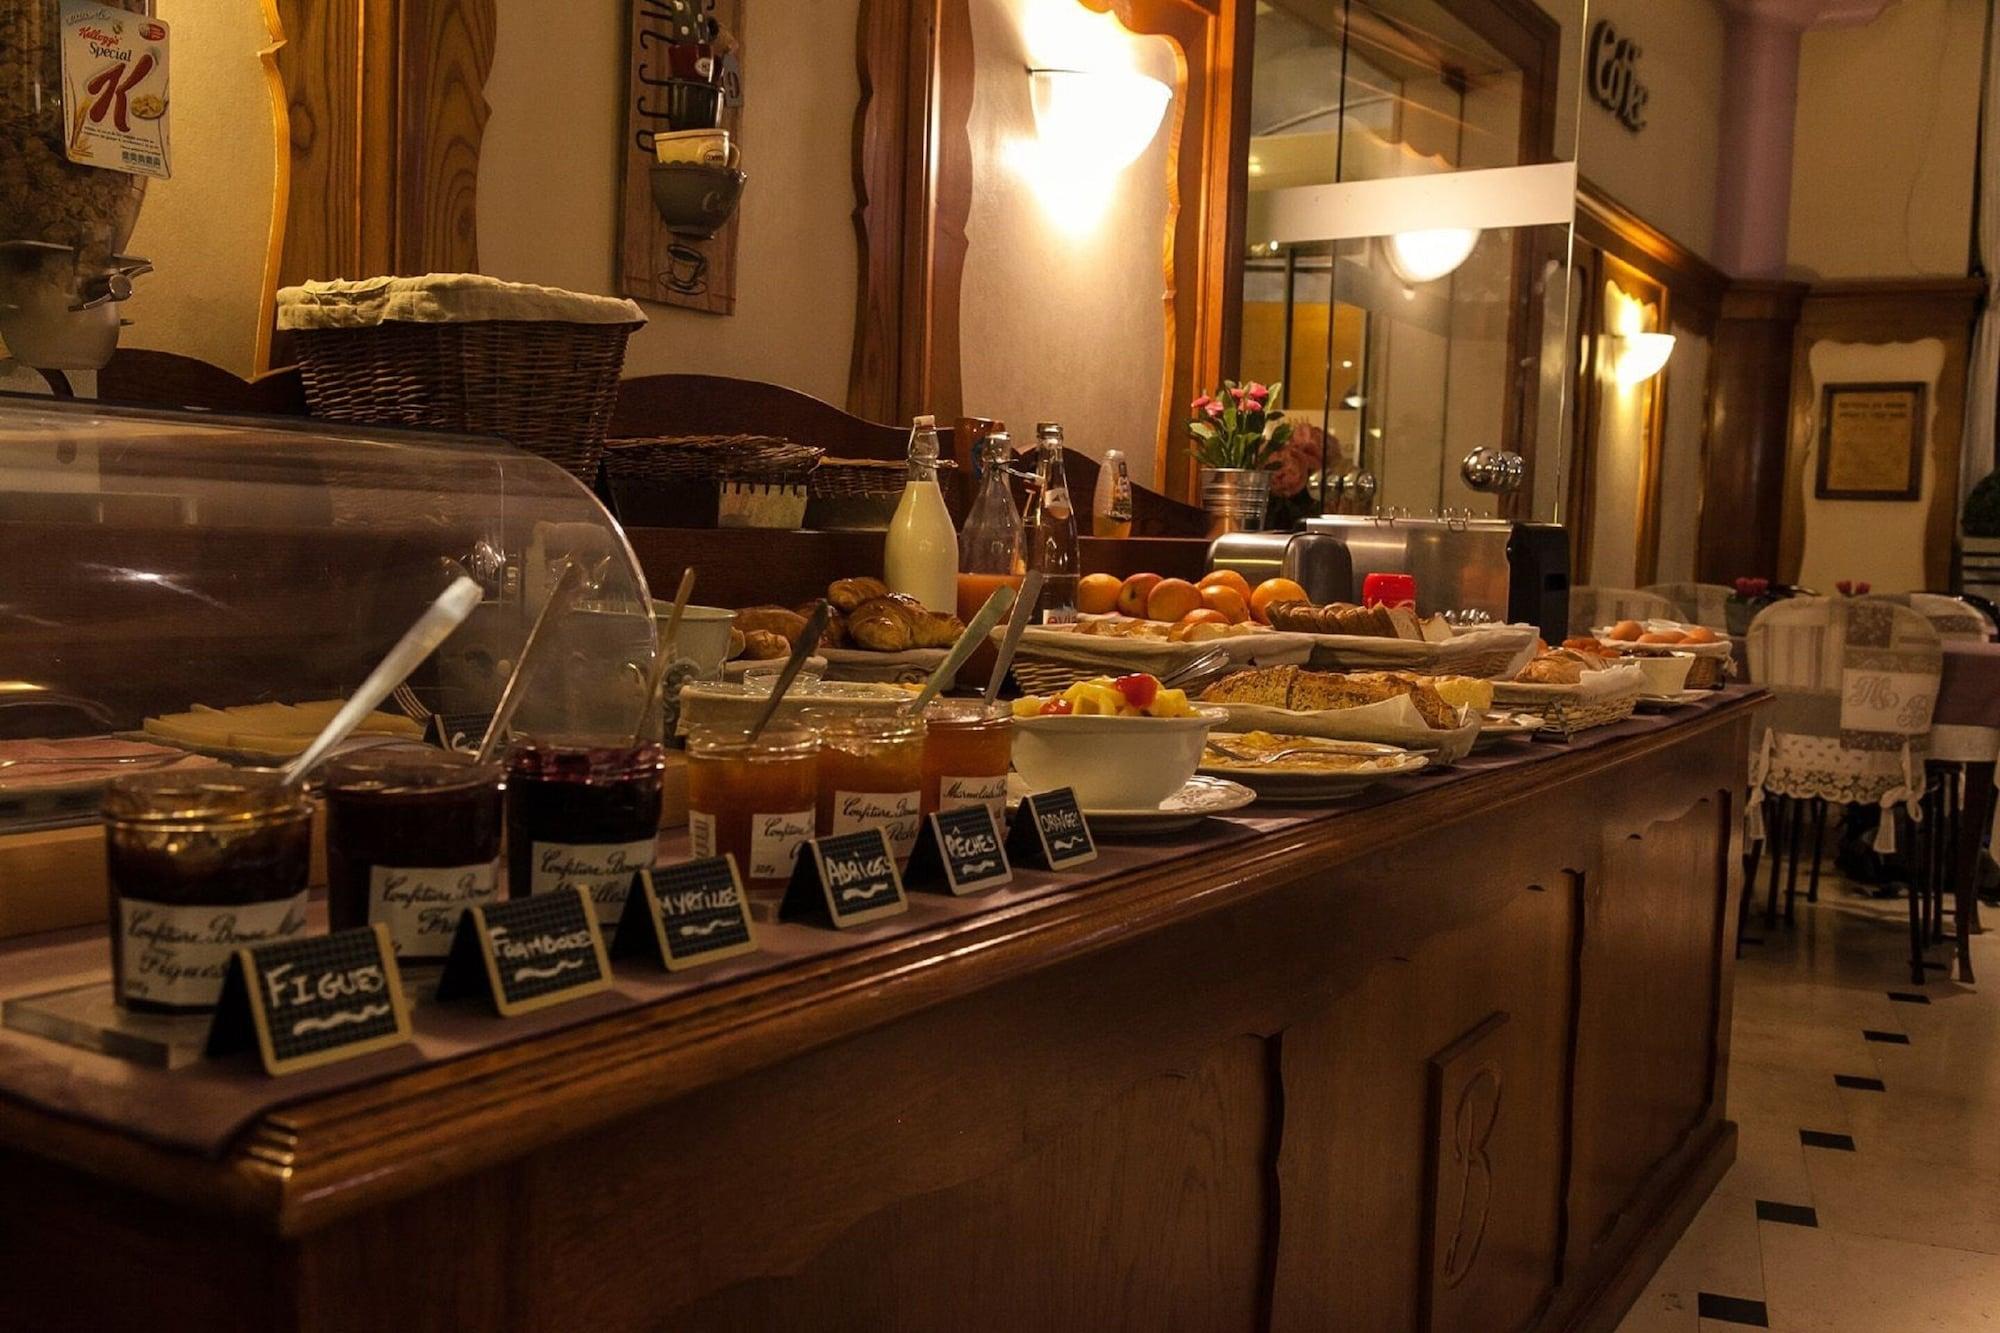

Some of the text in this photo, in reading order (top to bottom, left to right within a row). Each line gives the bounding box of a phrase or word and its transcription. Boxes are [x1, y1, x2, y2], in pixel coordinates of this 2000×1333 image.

[78, 26, 122, 47] Kellogg's
[89, 41, 132, 62] Special
[87, 54, 154, 133] K
